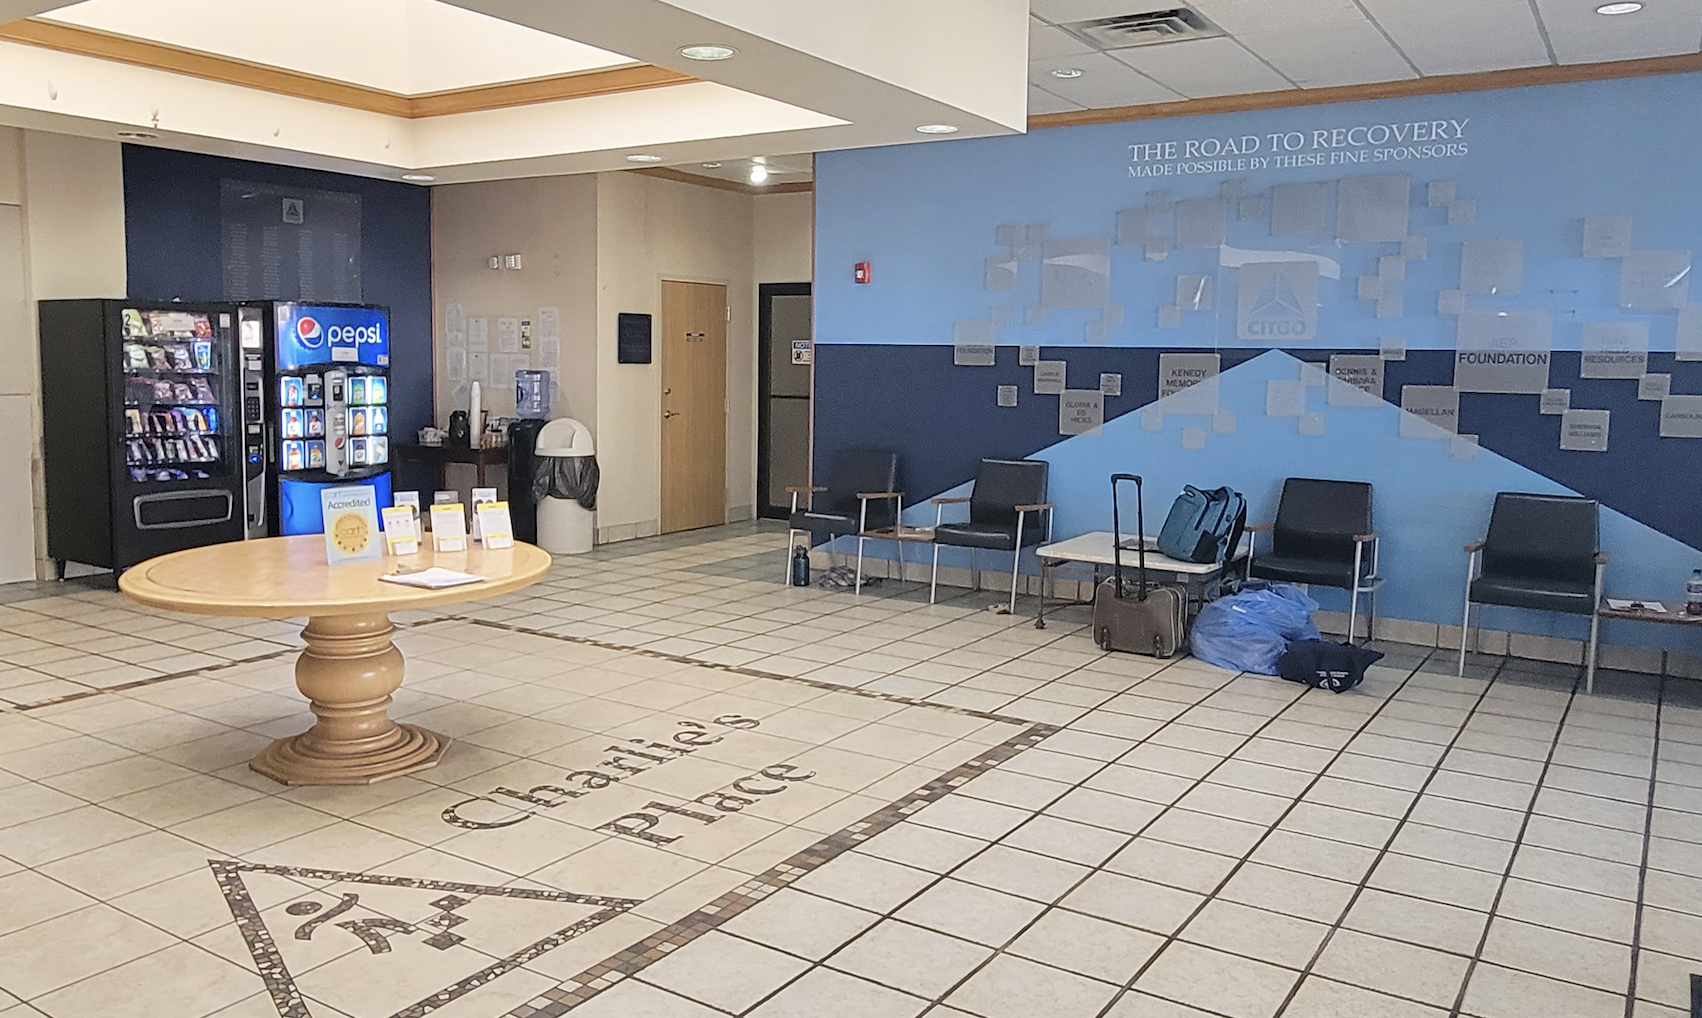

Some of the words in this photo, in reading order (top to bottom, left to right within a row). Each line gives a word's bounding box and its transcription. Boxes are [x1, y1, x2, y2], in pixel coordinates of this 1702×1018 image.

[1128, 141, 1177, 162] THE
[1184, 136, 1261, 158] ROAD
[1268, 131, 1304, 152] TO
[1312, 118, 1470, 149] RECOVERY
[1128, 163, 1173, 178] MADE
[1177, 158, 1247, 175] POSSIBLE
[1250, 156, 1270, 170] BY
[1273, 152, 1327, 168] THESE
[1330, 149, 1370, 164] FINE
[1373, 142, 1469, 162] SPONSORS
[327, 322, 382, 348] pepsi
[1246, 319, 1307, 336] CITGO
[1458, 352, 1548, 366] FOUNDATION
[1584, 355, 1646, 364] RESOURCES
[1171, 369, 1207, 378] KENEDY
[328, 499, 370, 509] Accredited
[441, 713, 761, 830] Charlie's
[594, 764, 817, 848] Place
